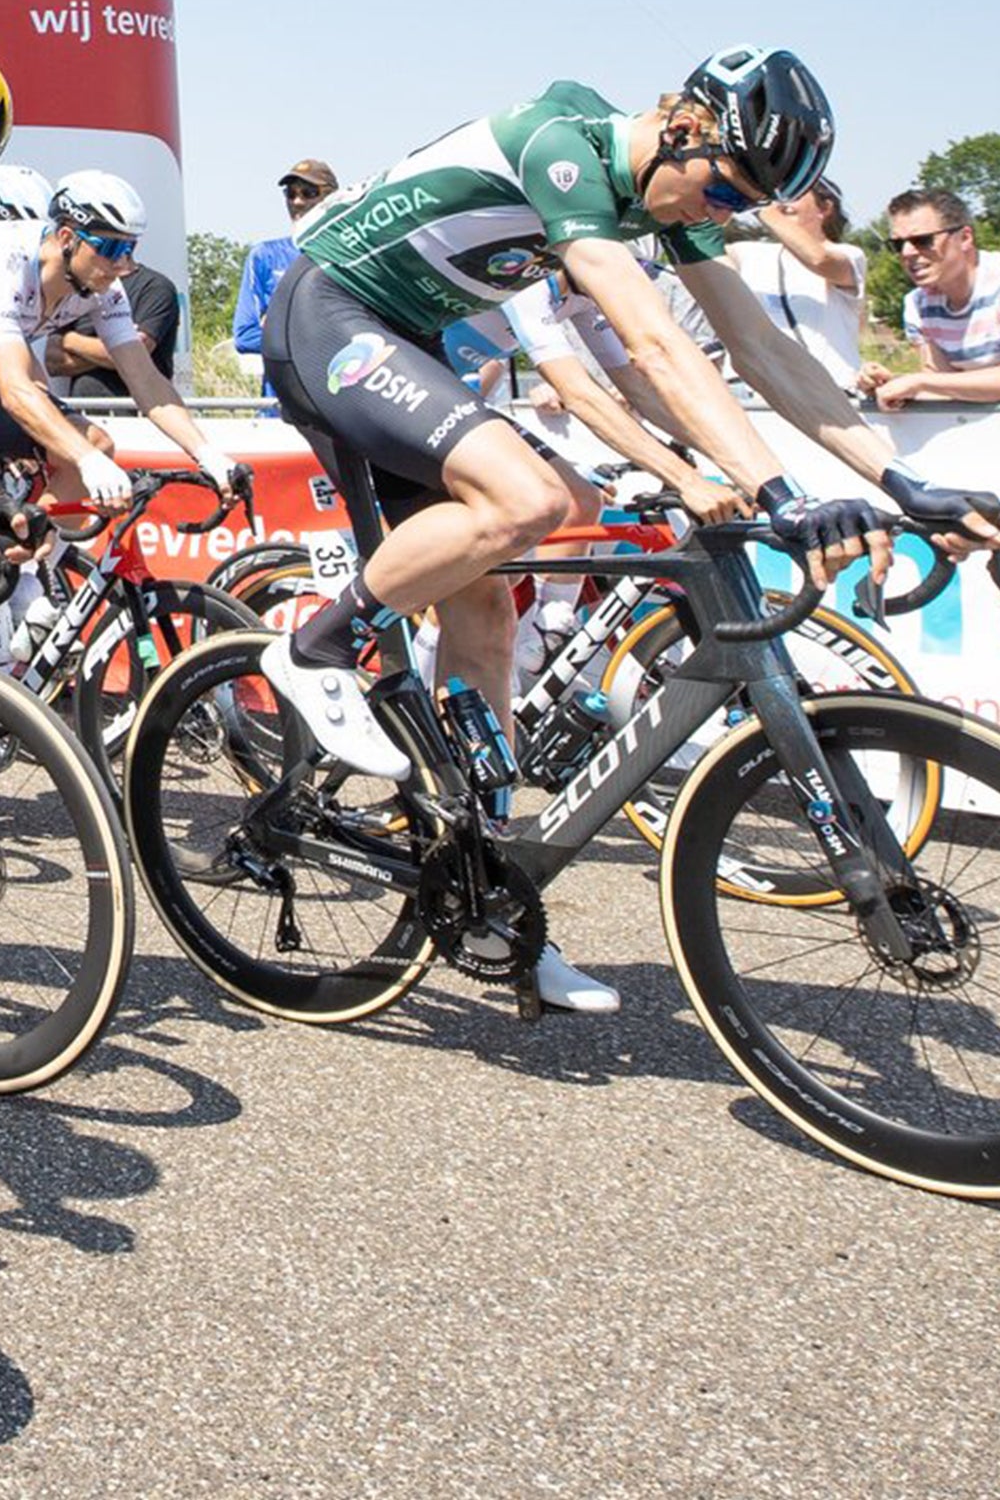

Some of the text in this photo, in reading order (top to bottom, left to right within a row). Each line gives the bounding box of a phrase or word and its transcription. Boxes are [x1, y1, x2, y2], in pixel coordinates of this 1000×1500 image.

[29, 0, 91, 43] wij
[363, 366, 429, 413] DSM
[316, 545, 350, 578] 35
[538, 687, 666, 843] SCOTT
[820, 824, 847, 857] DSM
[328, 852, 394, 883] SHIMANO
